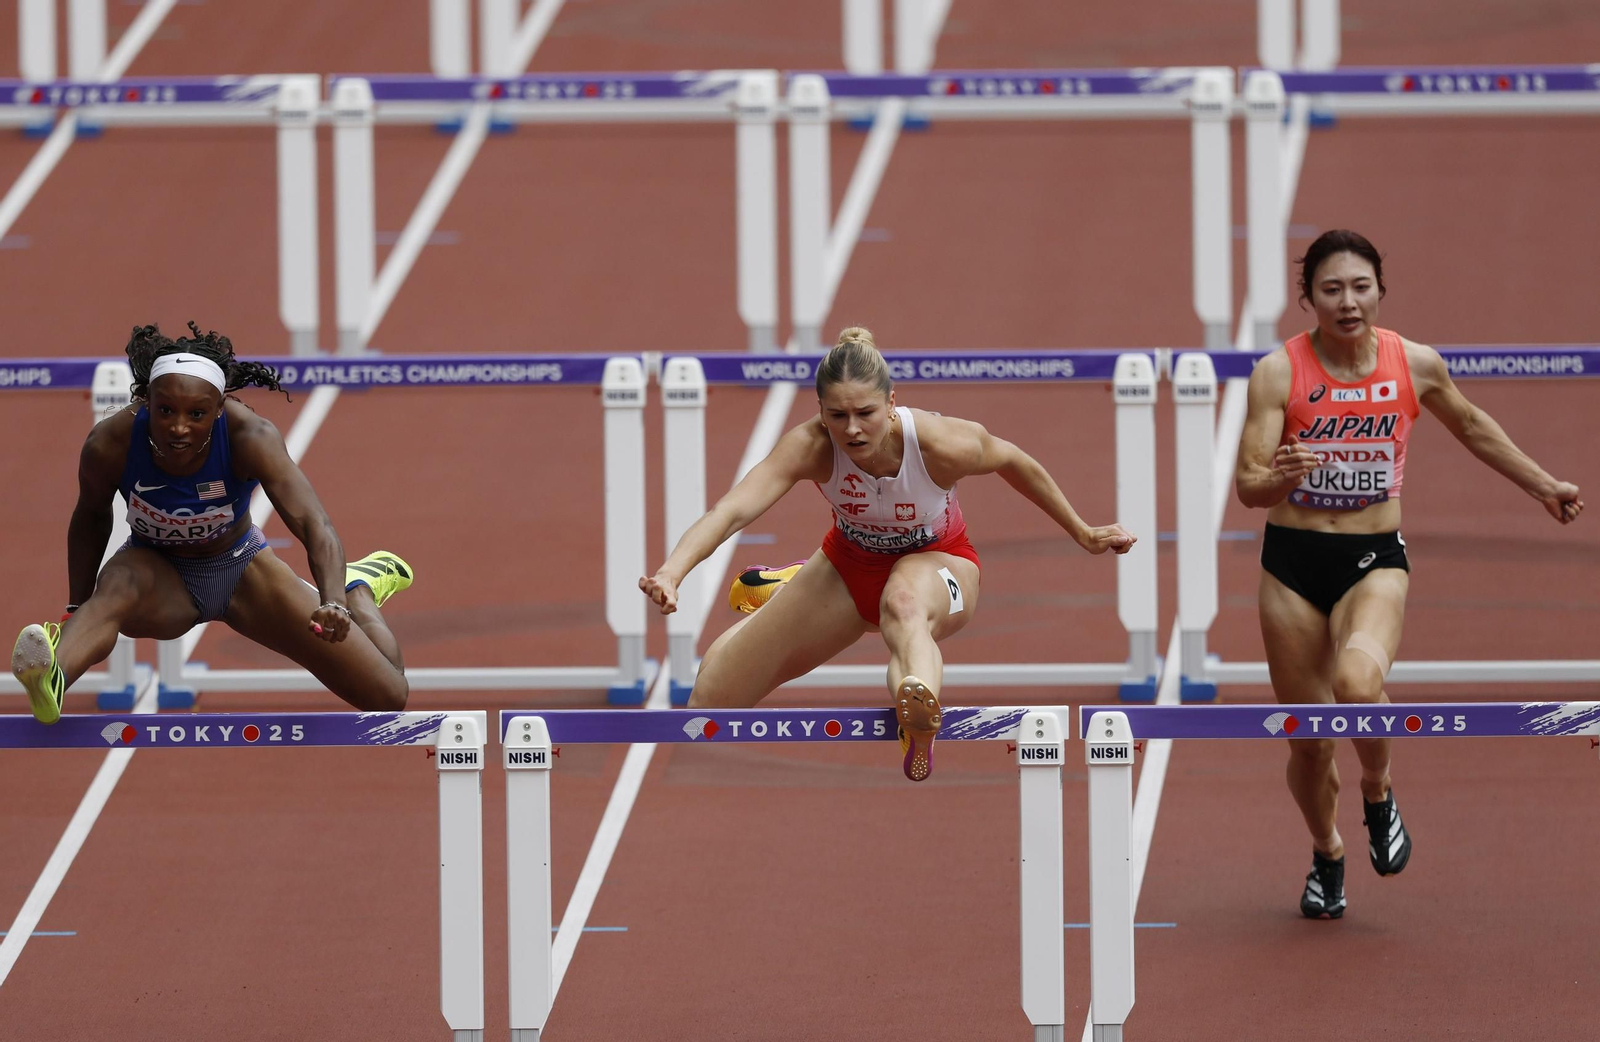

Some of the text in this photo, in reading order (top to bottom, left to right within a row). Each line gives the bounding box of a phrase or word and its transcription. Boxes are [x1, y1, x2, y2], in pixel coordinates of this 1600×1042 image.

[742, 361, 811, 379] WORLD
[918, 359, 1074, 378] CHAMPIONSHIPS
[1444, 355, 1584, 374] HAMPIONSHIPS
[302, 365, 403, 384] ATHLETICS
[407, 363, 562, 383] CHAMPIONSHIPS
[1333, 389, 1363, 400] ACN
[1299, 414, 1398, 439] JAPAN
[1313, 450, 1391, 463] ONDA
[1304, 470, 1387, 491] UKUBE
[840, 488, 866, 498] ORLEN
[131, 497, 229, 525] HONDA
[440, 752, 477, 764] NISHI
[509, 752, 545, 764] NISHI
[1021, 748, 1058, 760] NISHI
[1091, 747, 1127, 759] NISHI
